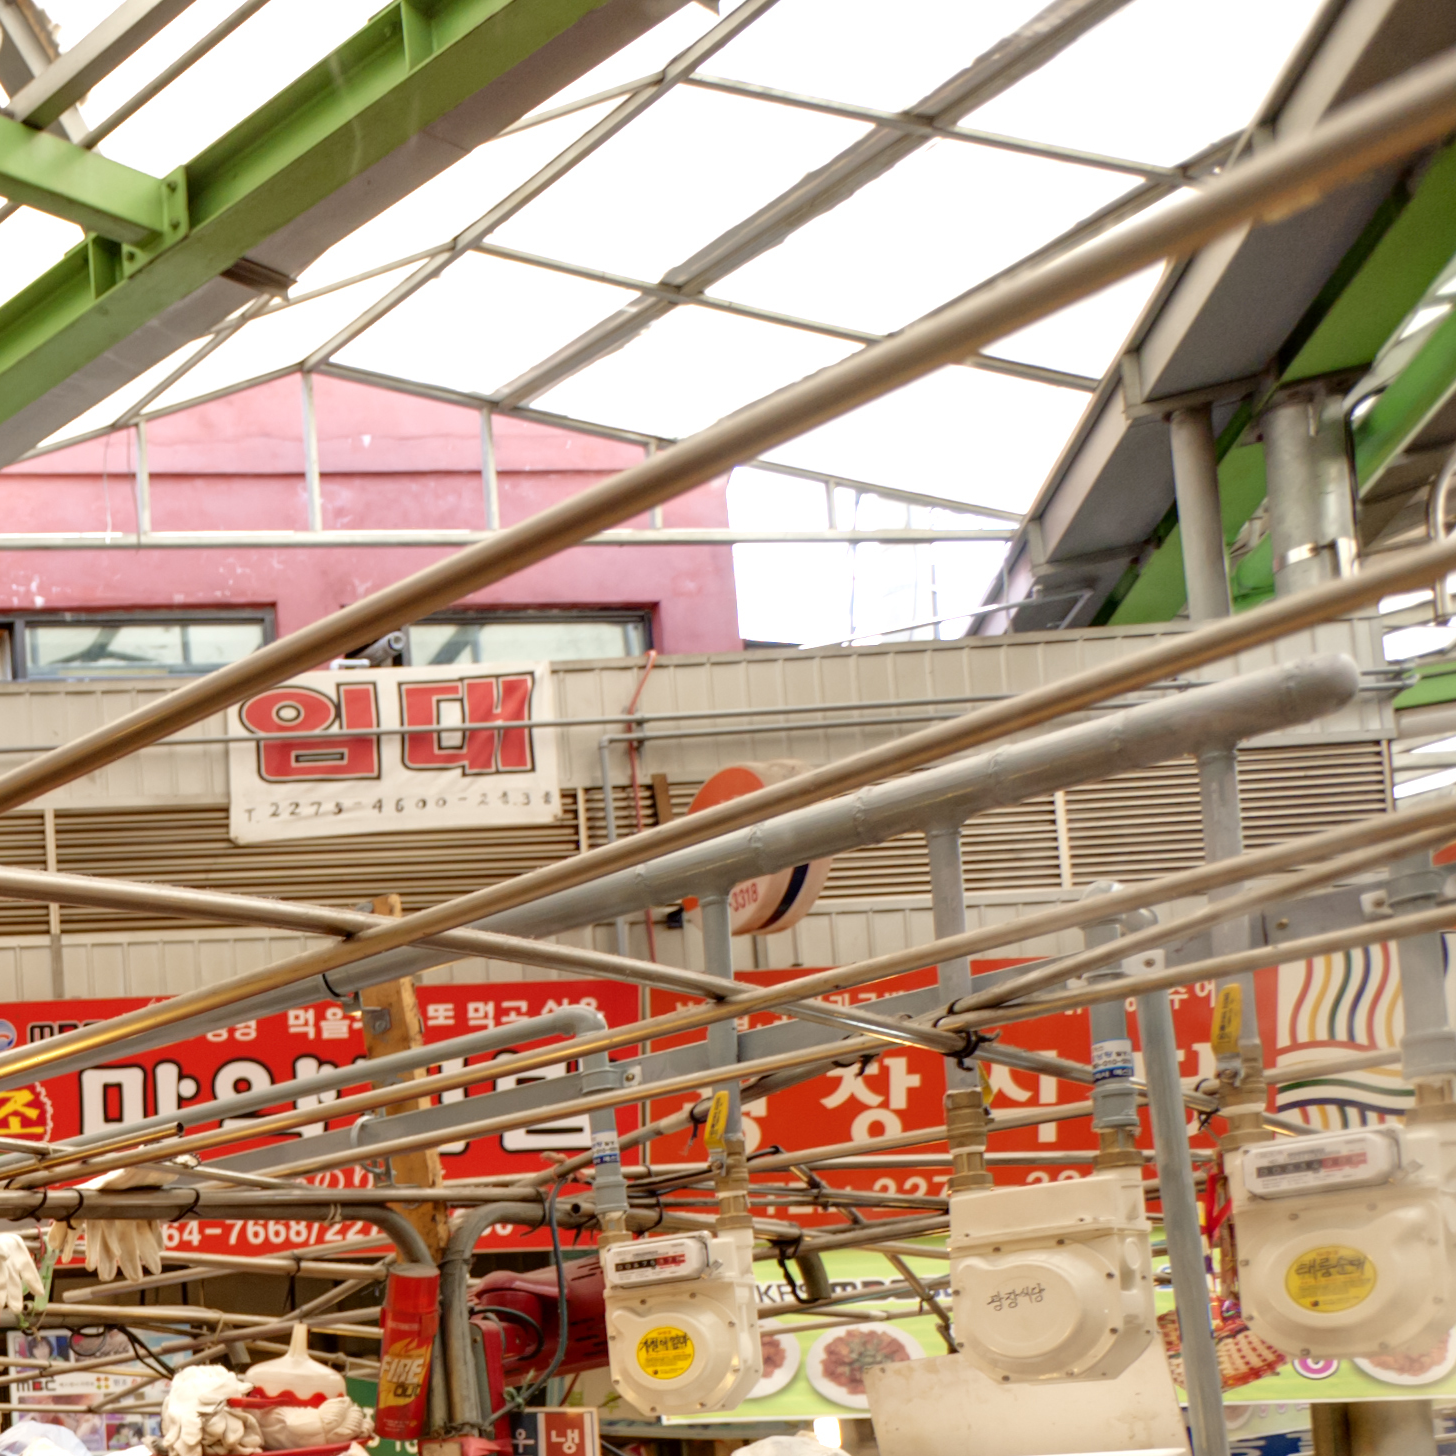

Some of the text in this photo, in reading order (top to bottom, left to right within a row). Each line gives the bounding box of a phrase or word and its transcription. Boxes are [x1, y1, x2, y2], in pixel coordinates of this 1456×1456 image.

[288, 1007, 365, 1040] 먹을
[427, 1003, 455, 1027] 또
[380, 1355, 425, 1384] FIRE
